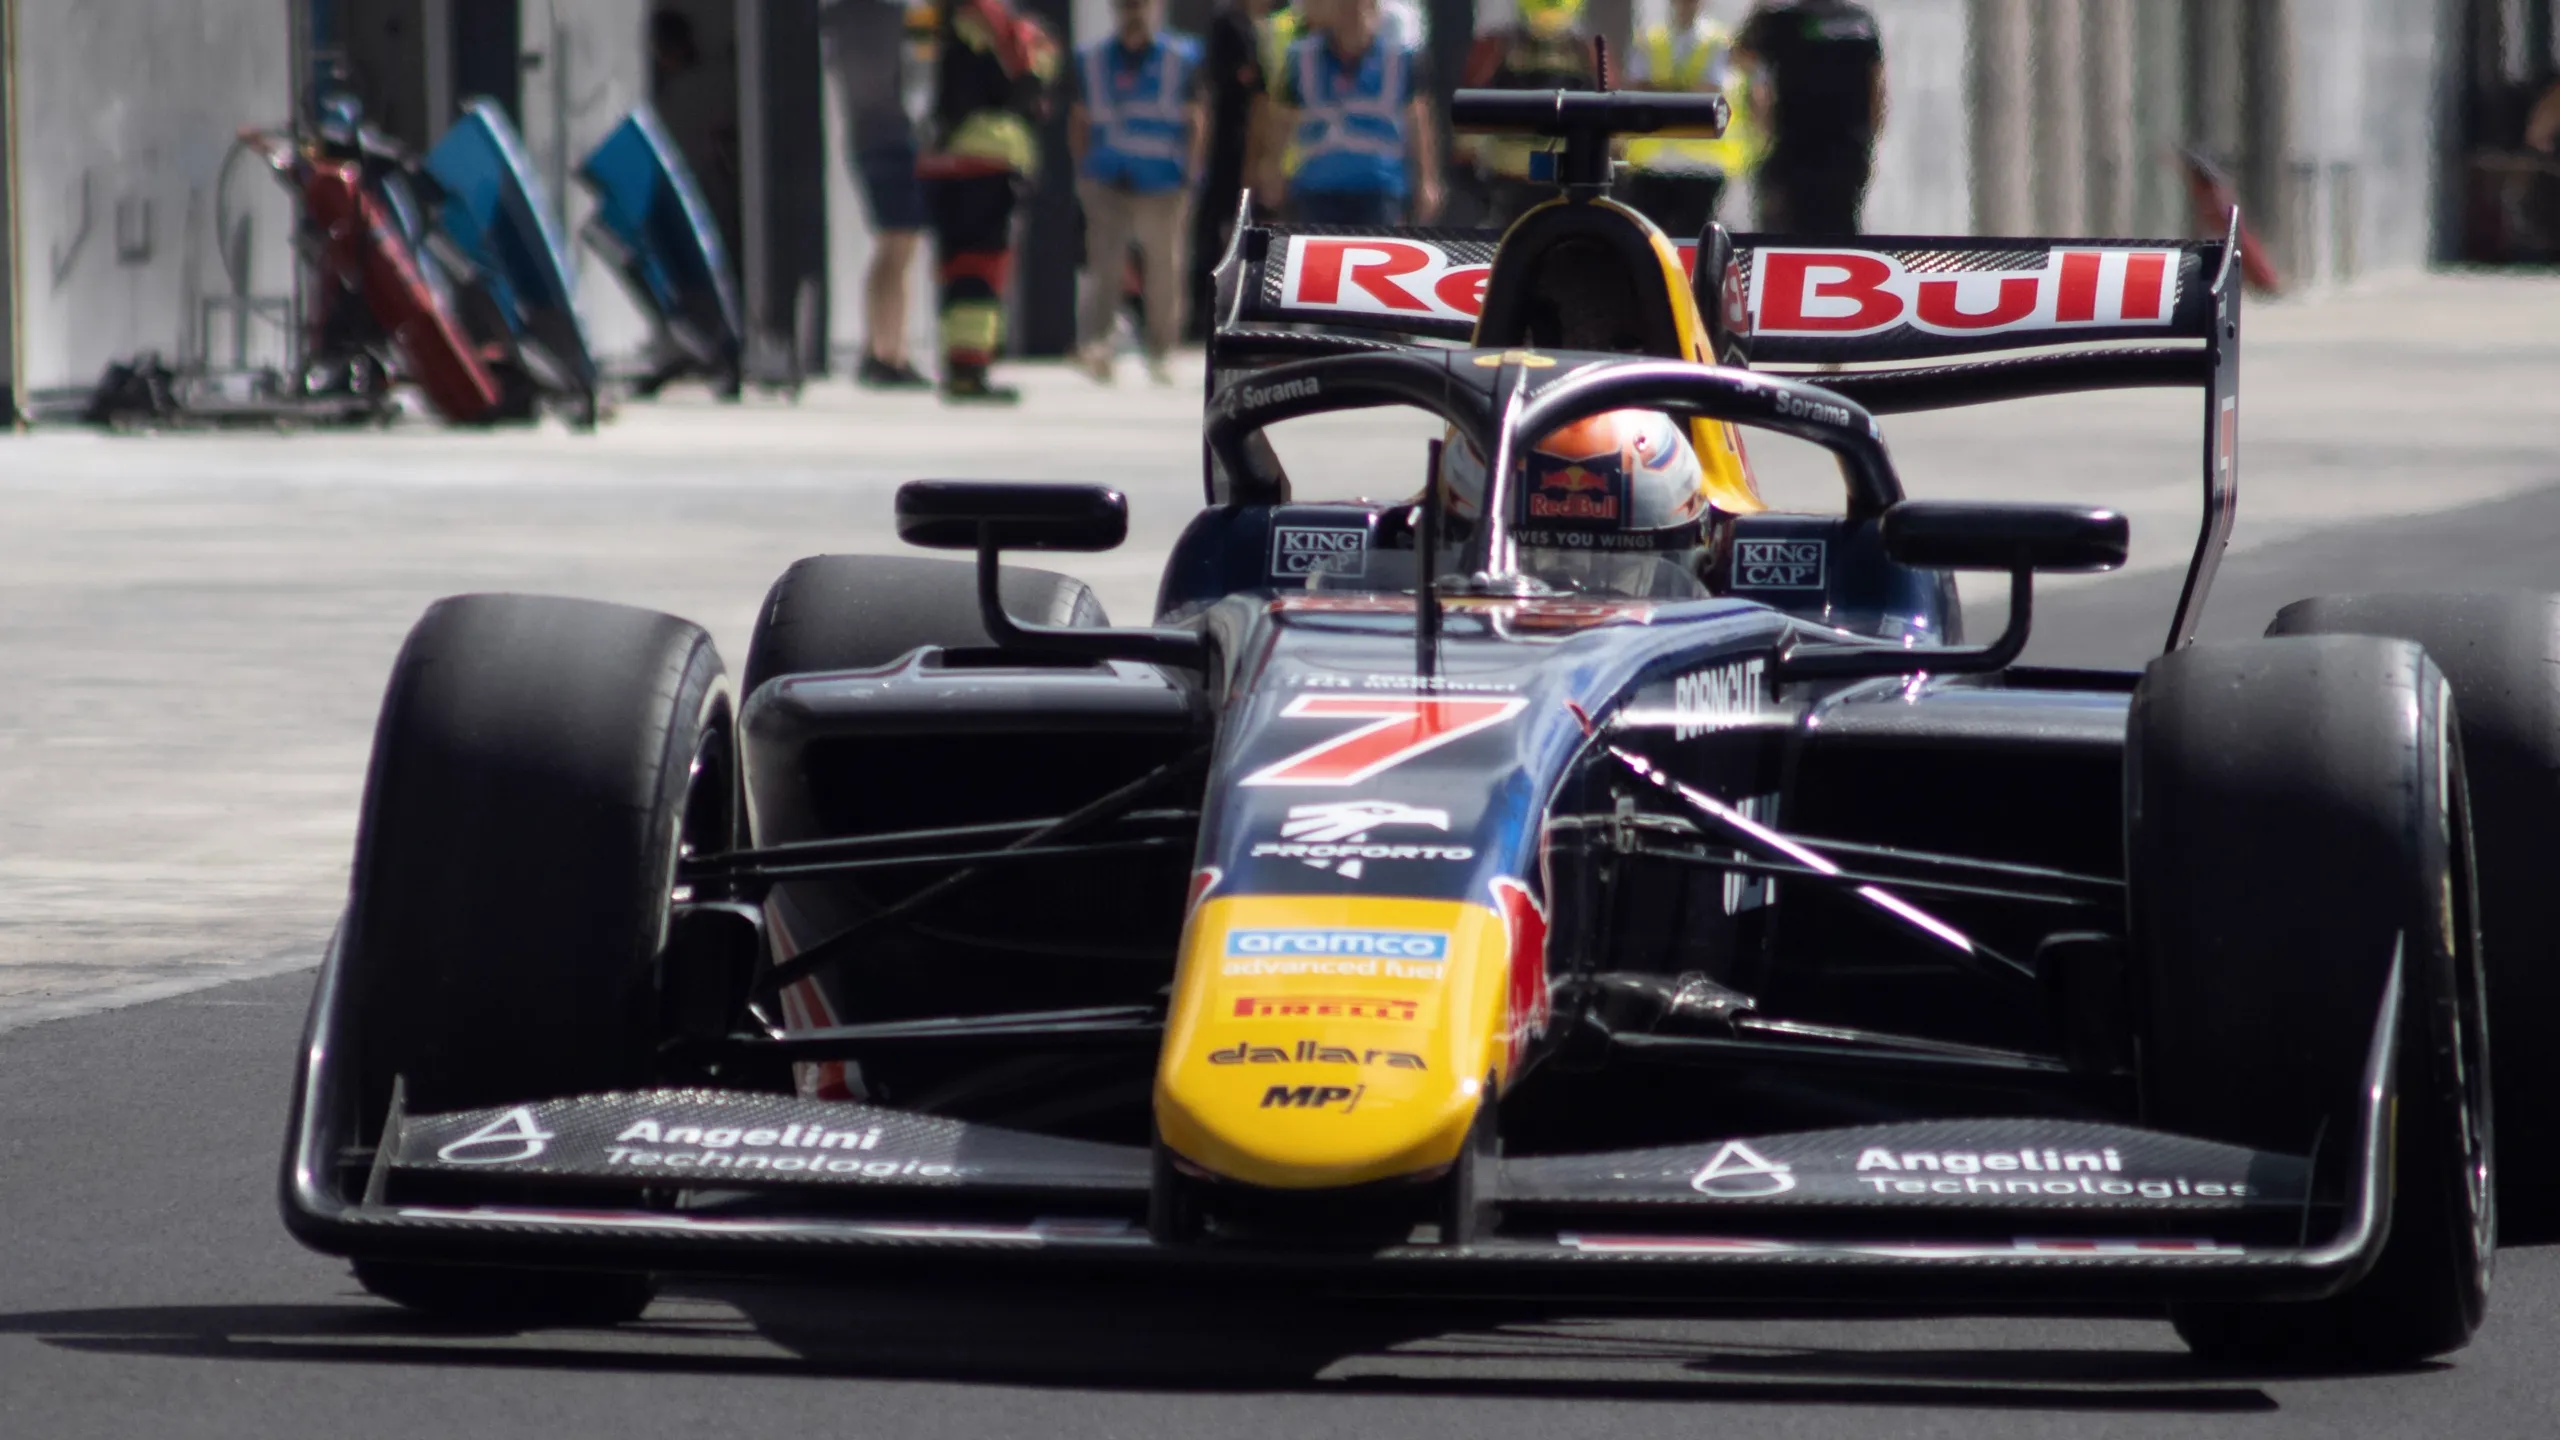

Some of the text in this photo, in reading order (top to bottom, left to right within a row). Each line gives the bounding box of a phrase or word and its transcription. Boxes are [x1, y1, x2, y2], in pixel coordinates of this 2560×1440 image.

[1759, 250, 2168, 331] Bull
[1242, 376, 1320, 409] Sorama
[1775, 389, 1850, 426] Sorama
[1532, 494, 1618, 519] Red Bull
[1284, 532, 1359, 551] KING
[1556, 532, 1594, 546] YOU
[1601, 534, 1656, 548] WINGS
[1287, 553, 1350, 572] CAP
[1743, 544, 1818, 563] KING
[1746, 566, 1806, 585] CAP
[1238, 694, 1530, 786] 7
[1251, 842, 1475, 861] PROFORTO
[1238, 933, 1435, 956] aramco
[1222, 957, 1444, 980] advanced fuel
[1233, 996, 1419, 1020] PIRELLI
[1207, 1040, 1428, 1071] dallara
[616, 1119, 882, 1152] Angelini
[1856, 1149, 2122, 1174] Angelini
[1859, 1175, 2250, 1198] Technologies
